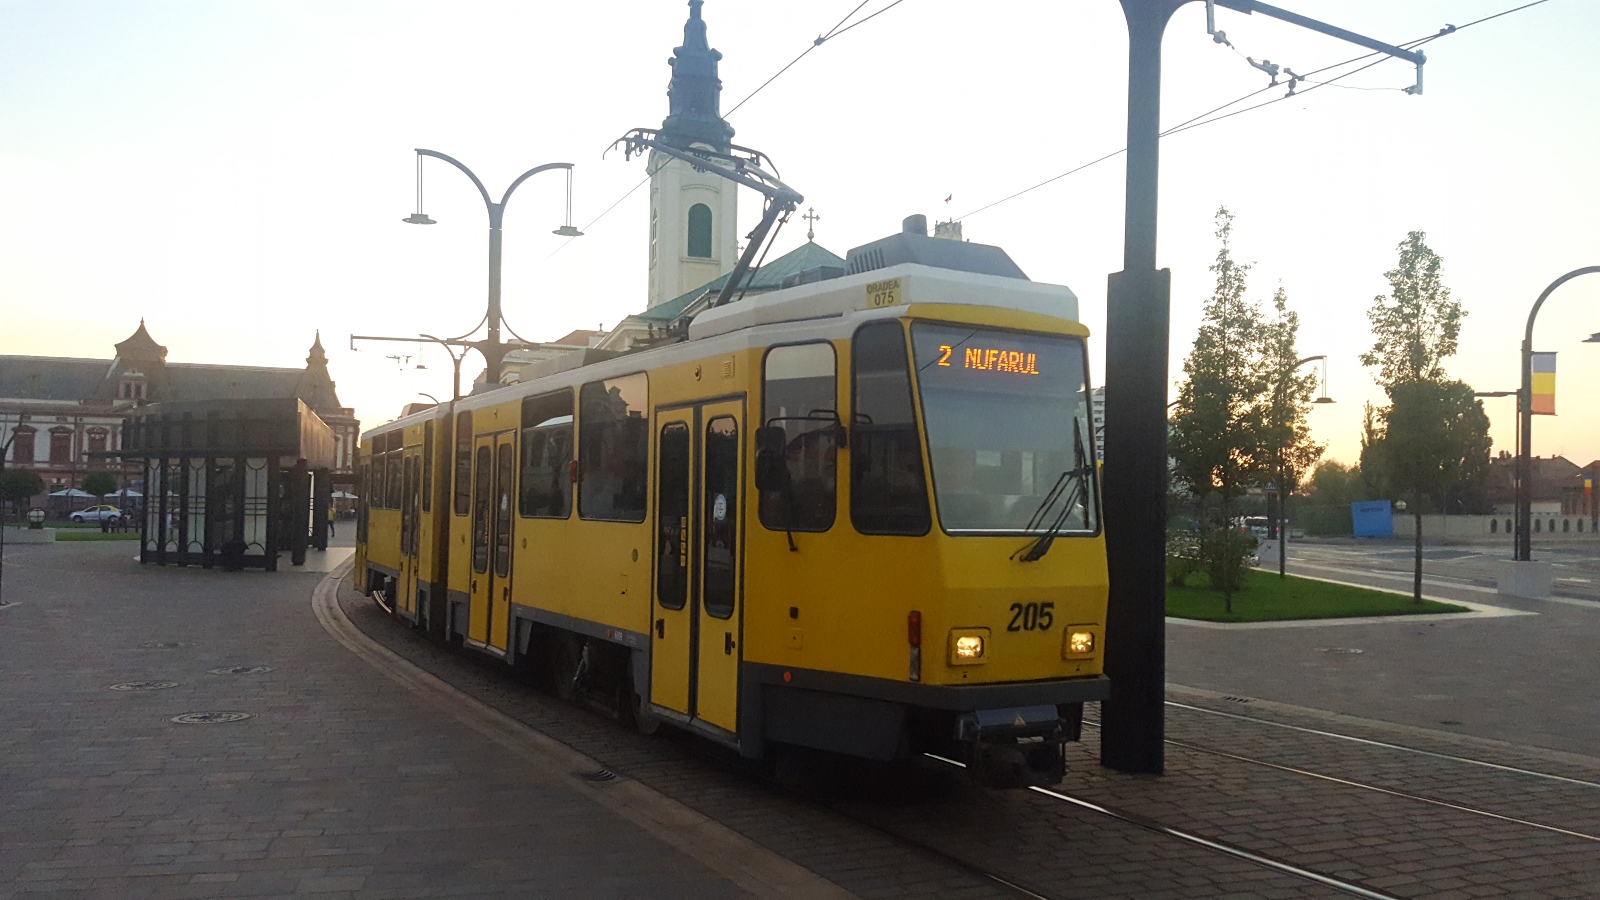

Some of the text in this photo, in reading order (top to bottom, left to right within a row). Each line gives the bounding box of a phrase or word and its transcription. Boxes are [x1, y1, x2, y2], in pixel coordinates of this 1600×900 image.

[866, 279, 900, 294] ORADEA
[874, 291, 894, 306] 075
[938, 344, 1040, 375] 2 NUFARUL
[1006, 601, 1055, 632] 205
